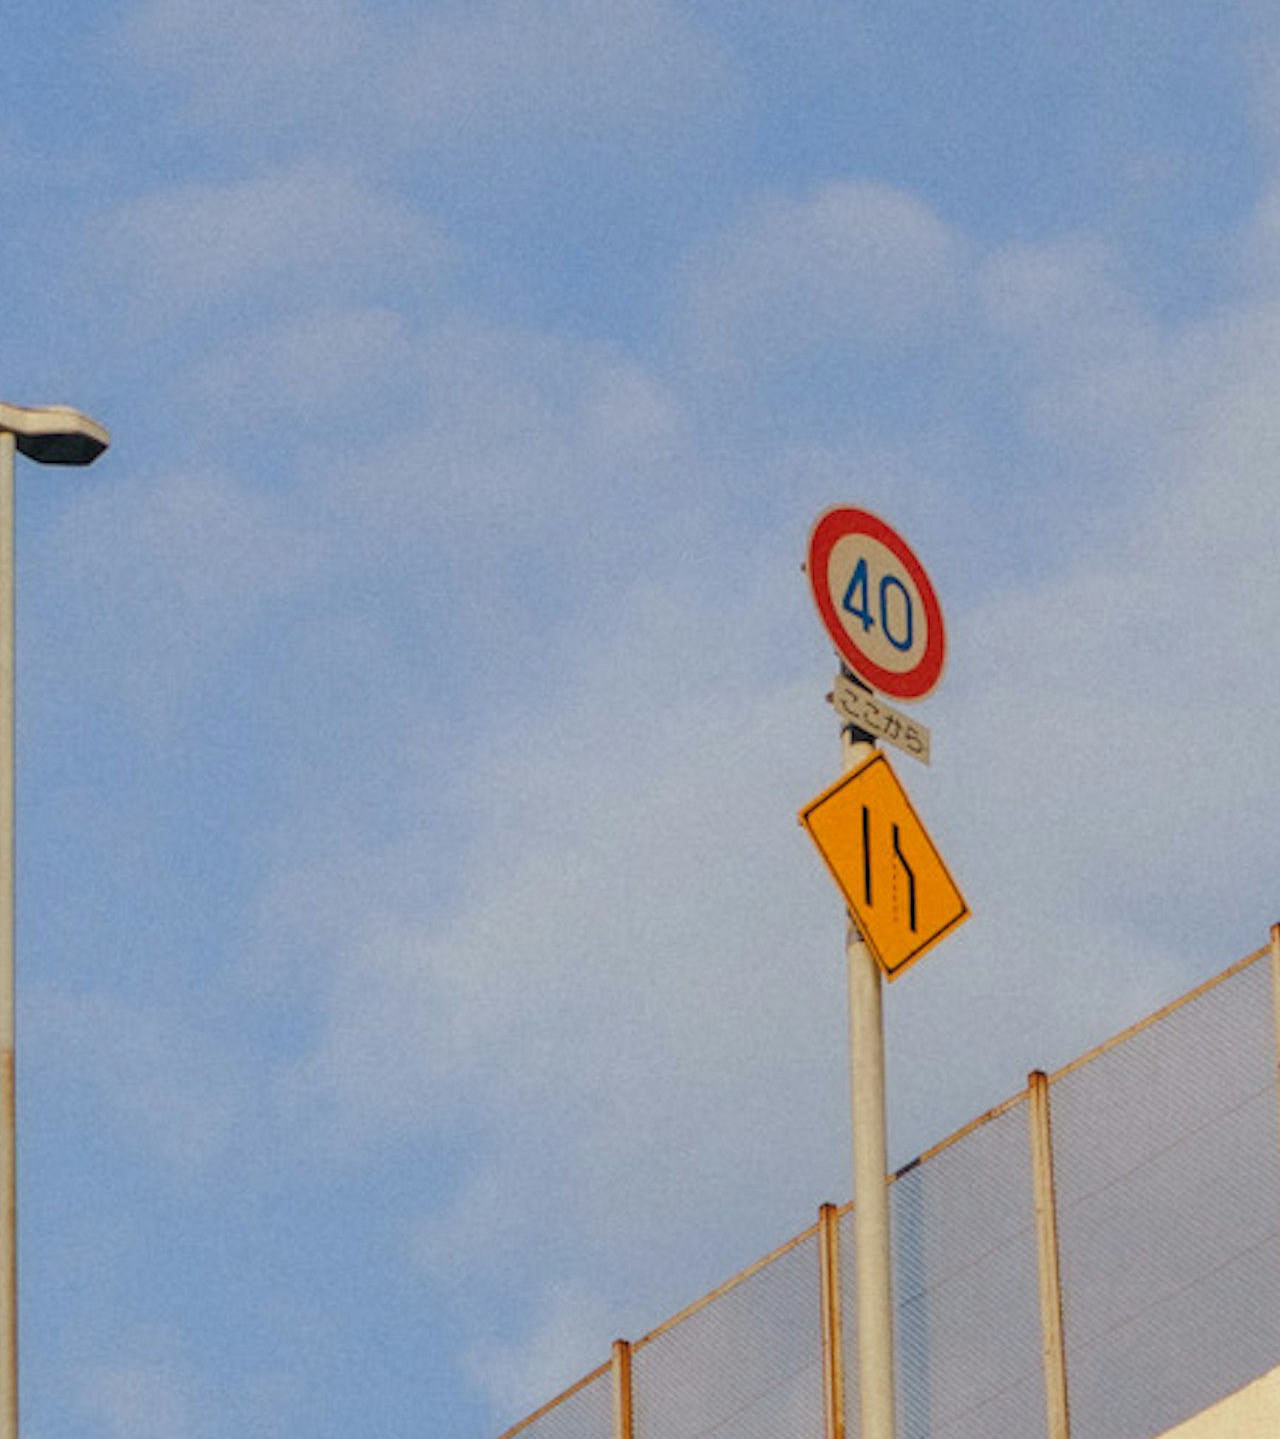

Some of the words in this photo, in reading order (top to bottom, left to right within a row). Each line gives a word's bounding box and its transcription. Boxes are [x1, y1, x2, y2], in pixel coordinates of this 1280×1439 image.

[842, 558, 912, 652] 40
[840, 688, 924, 753] ここから
